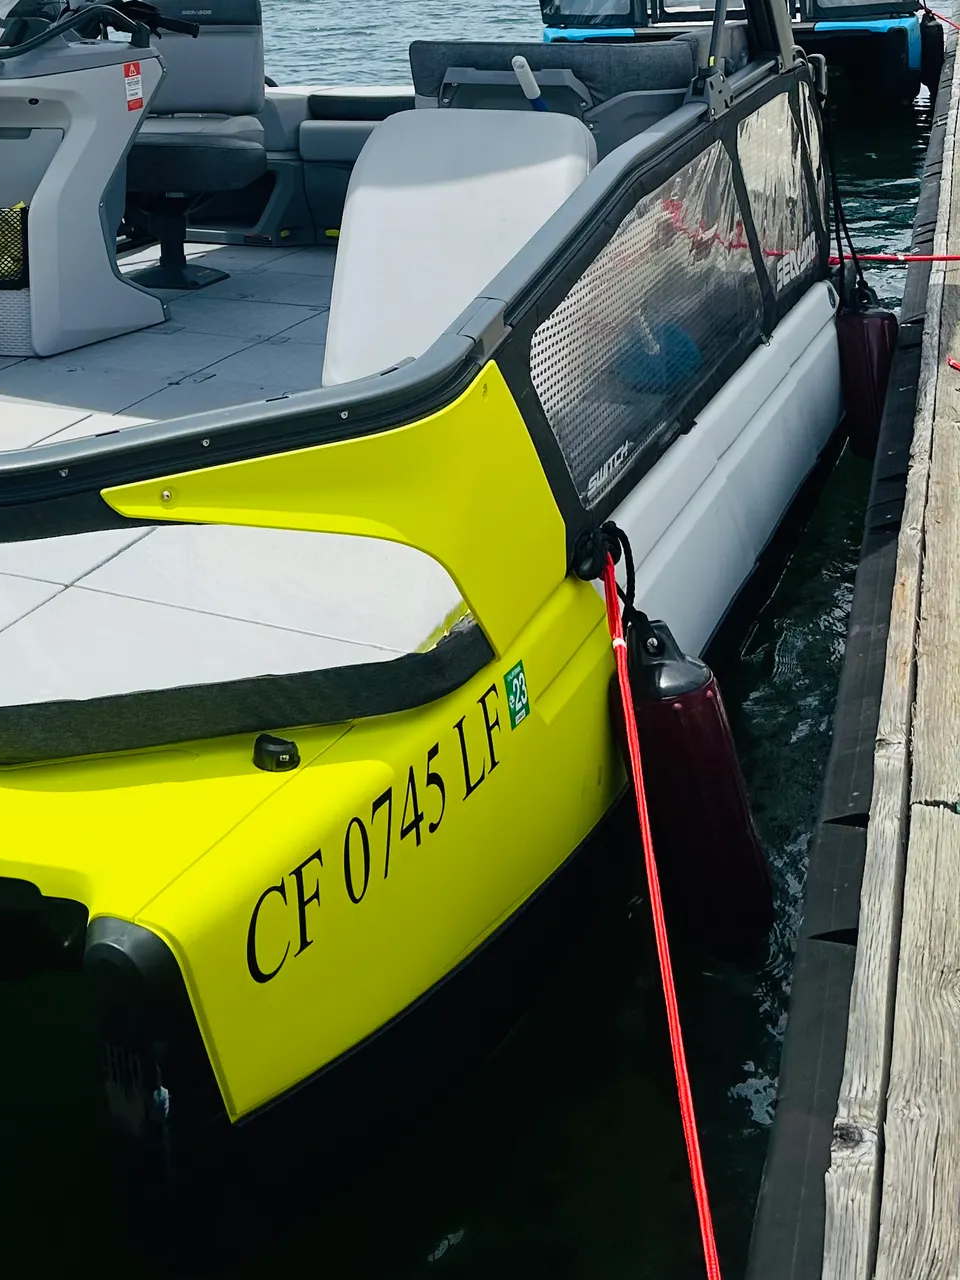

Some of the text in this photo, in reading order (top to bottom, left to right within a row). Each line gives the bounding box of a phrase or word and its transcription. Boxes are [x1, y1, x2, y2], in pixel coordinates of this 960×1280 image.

[512, 672, 528, 712] 23
[246, 683, 501, 984] CF 0745 LF
